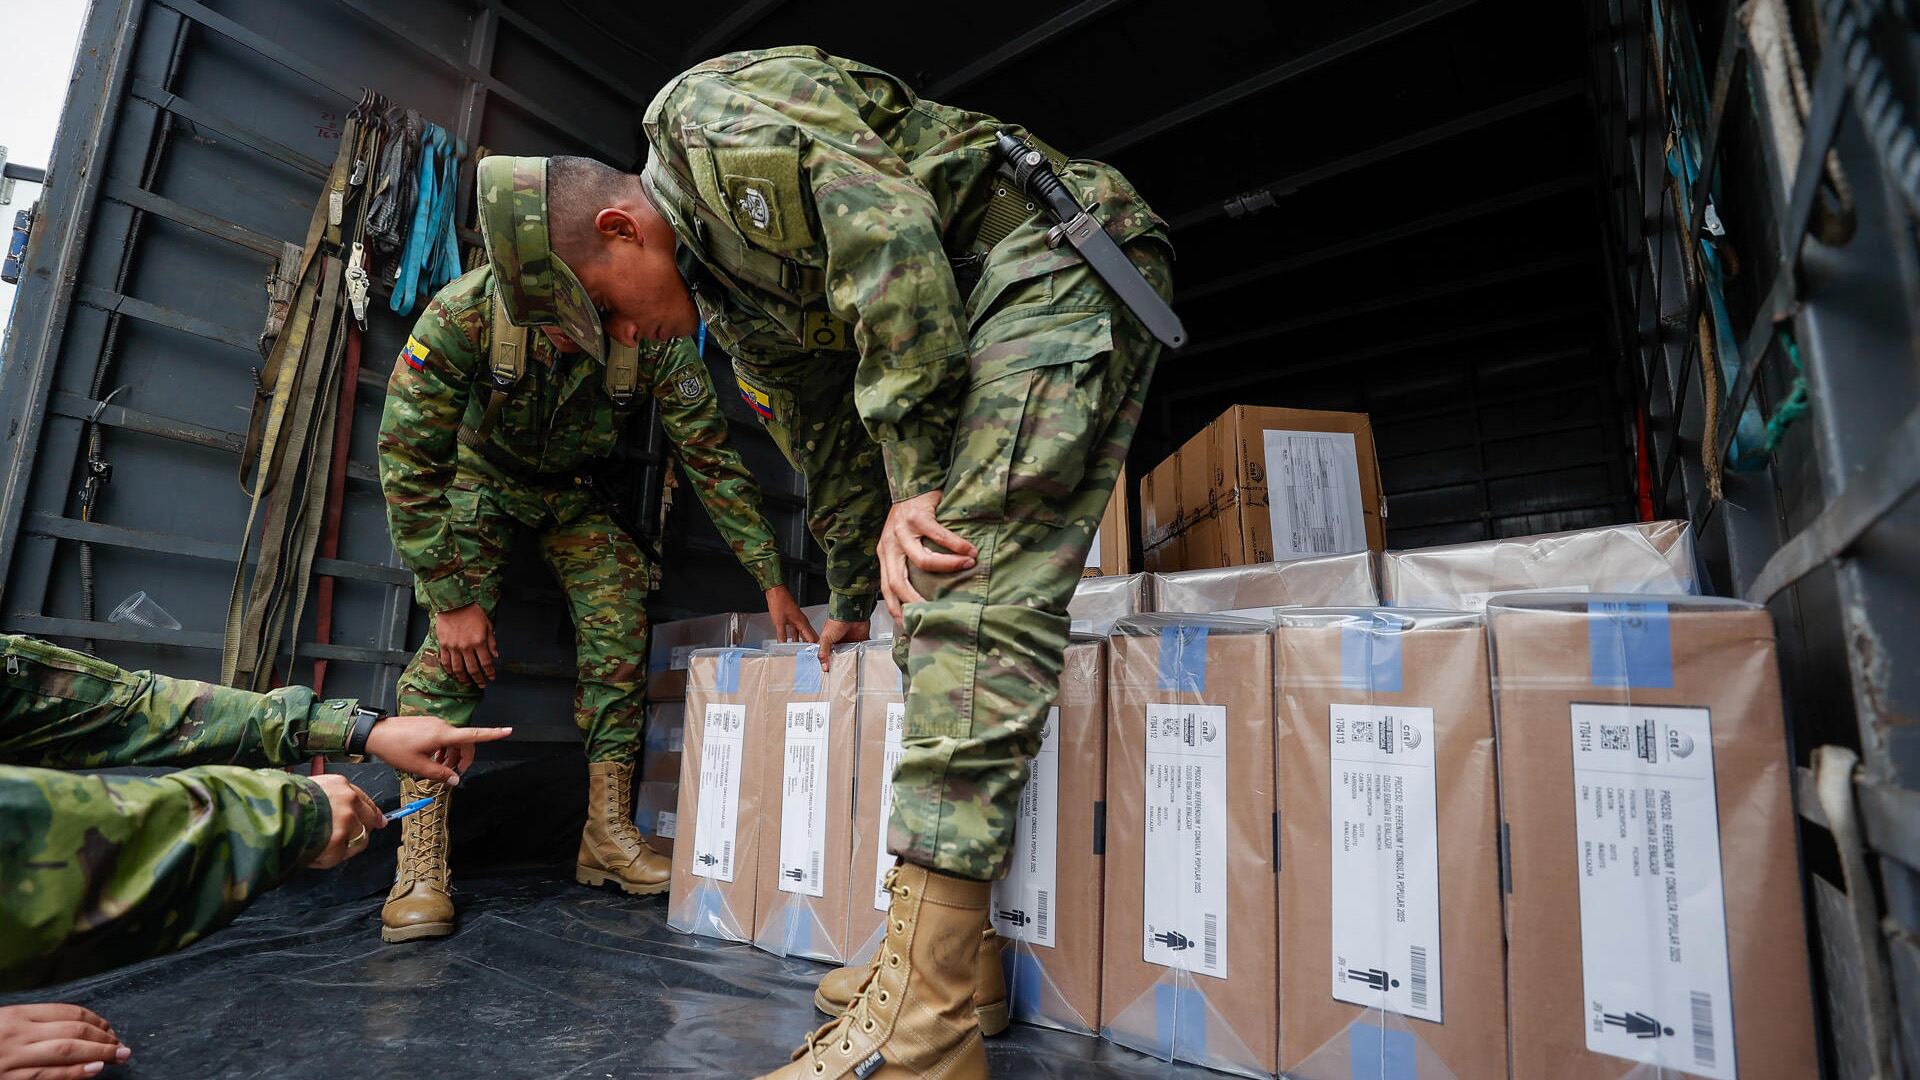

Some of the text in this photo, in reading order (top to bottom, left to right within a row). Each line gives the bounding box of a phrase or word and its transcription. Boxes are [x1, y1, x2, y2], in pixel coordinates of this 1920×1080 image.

[1150, 716, 1158, 738] 1704112
[1335, 718, 1344, 744] 1704113
[1579, 721, 1591, 752] 1704114
[1395, 776, 1403, 803] PROCESO:
[1660, 790, 1672, 821] PROCESO:
[1194, 830, 1202, 856] CONSULTA
[1194, 857, 1202, 880] POPULAR
[1396, 850, 1405, 879] CONSULTA
[1194, 882, 1202, 893] 2025
[1396, 880, 1405, 908] POPULAR
[1665, 876, 1678, 912] CONSULTA
[1397, 909, 1405, 923] 2025
[1667, 914, 1679, 945] POPULAR
